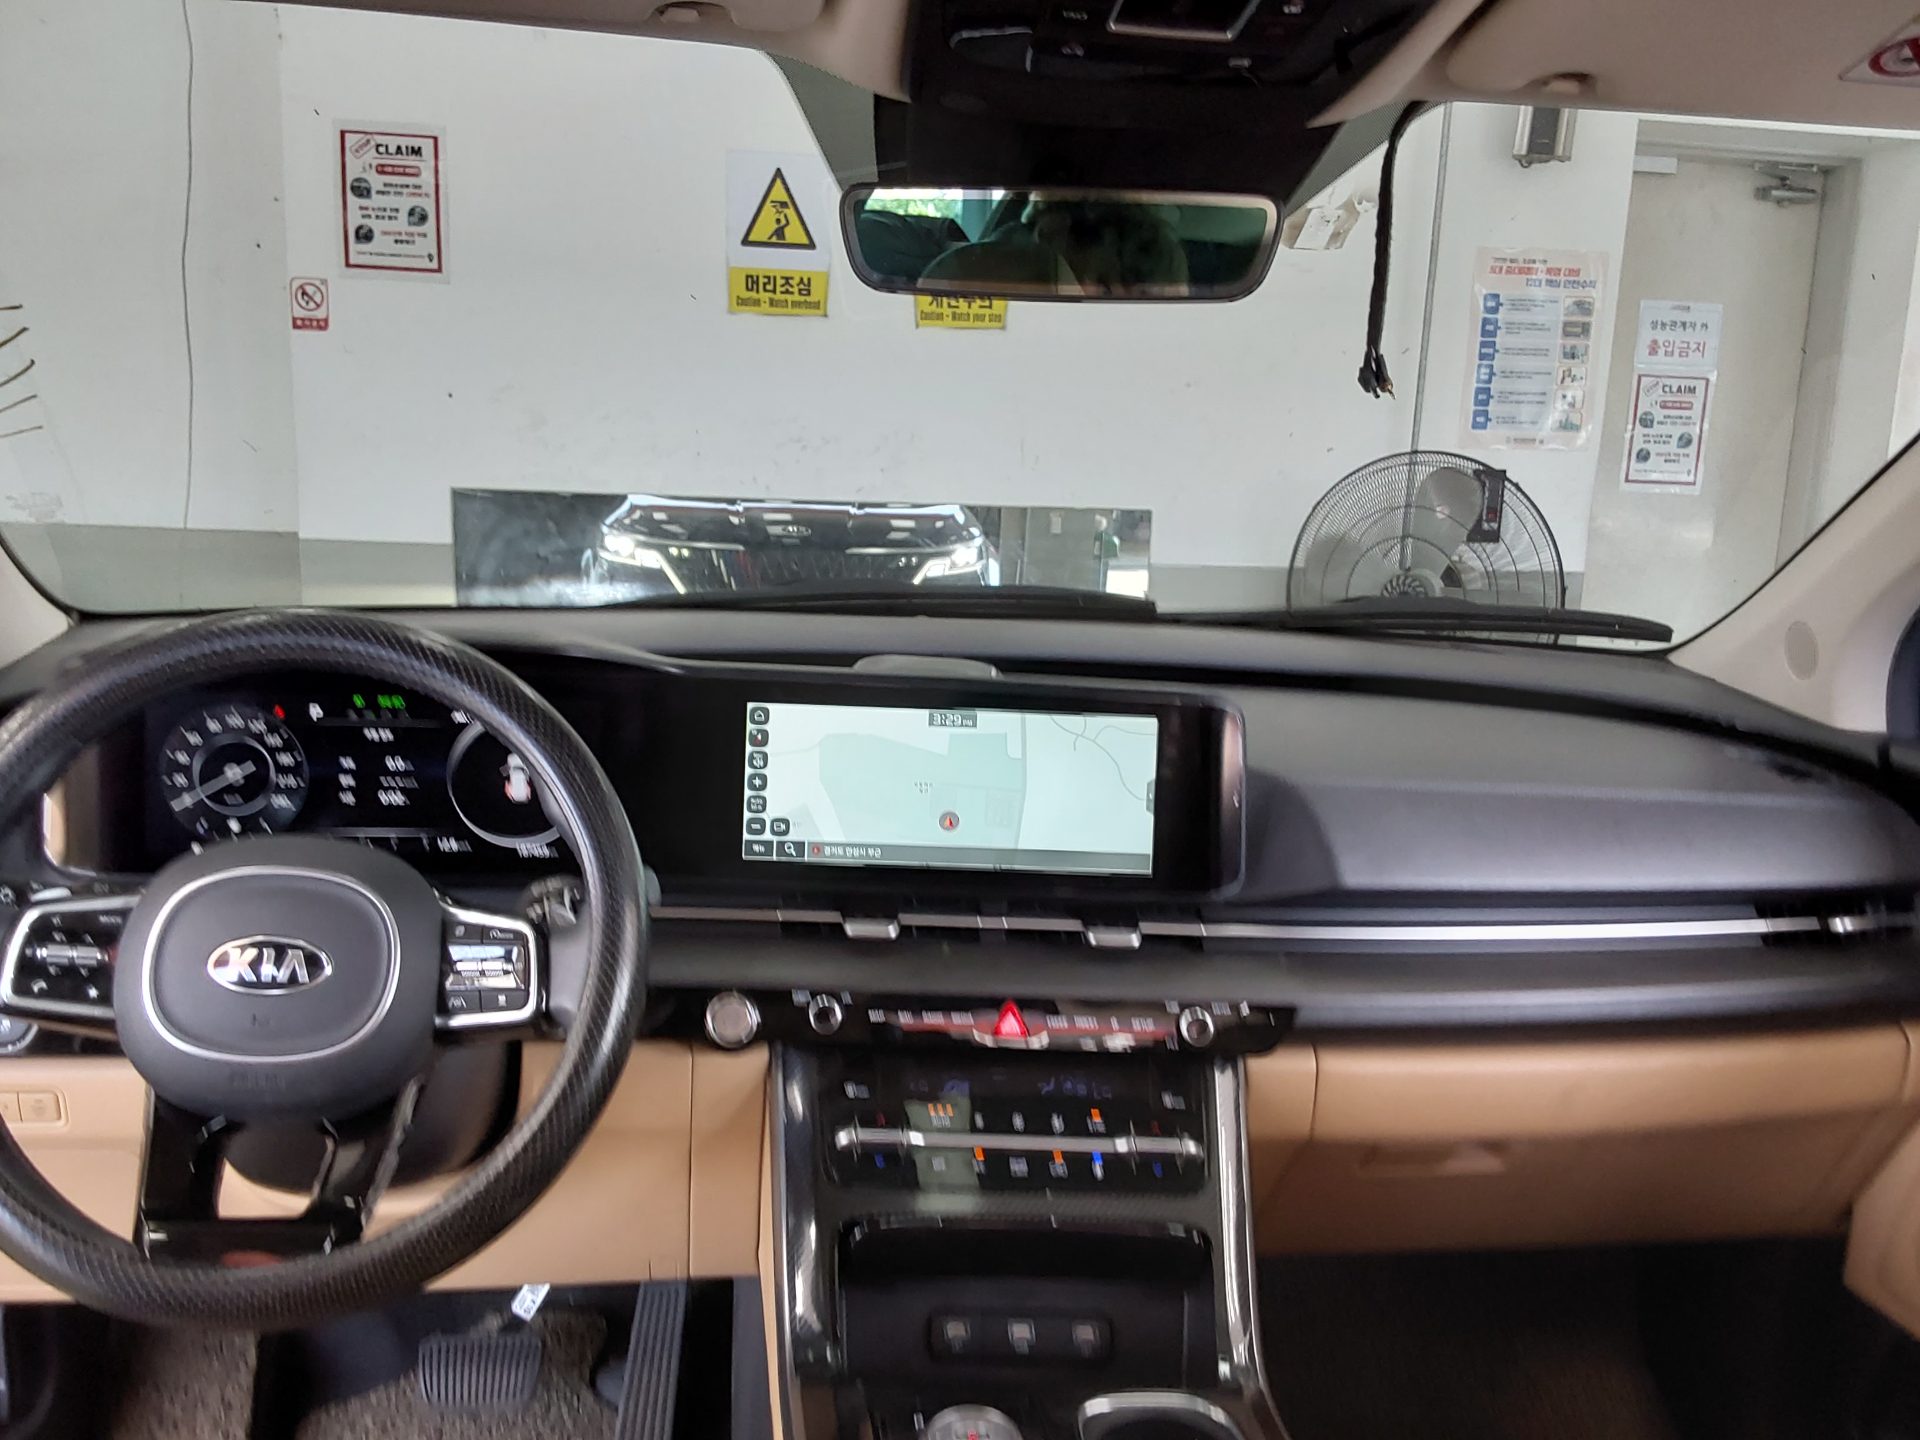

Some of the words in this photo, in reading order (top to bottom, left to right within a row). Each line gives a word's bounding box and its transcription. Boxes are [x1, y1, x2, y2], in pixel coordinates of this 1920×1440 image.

[375, 144, 422, 157] CLAIM
[745, 274, 812, 296] 머리조심
[736, 296, 761, 307] Caution
[920, 310, 943, 321] Caution
[1649, 319, 1697, 332] 성능관계자
[1646, 338, 1706, 359] 출입금지
[1661, 383, 1697, 395] CLAIM
[224, 946, 310, 984] KIA
